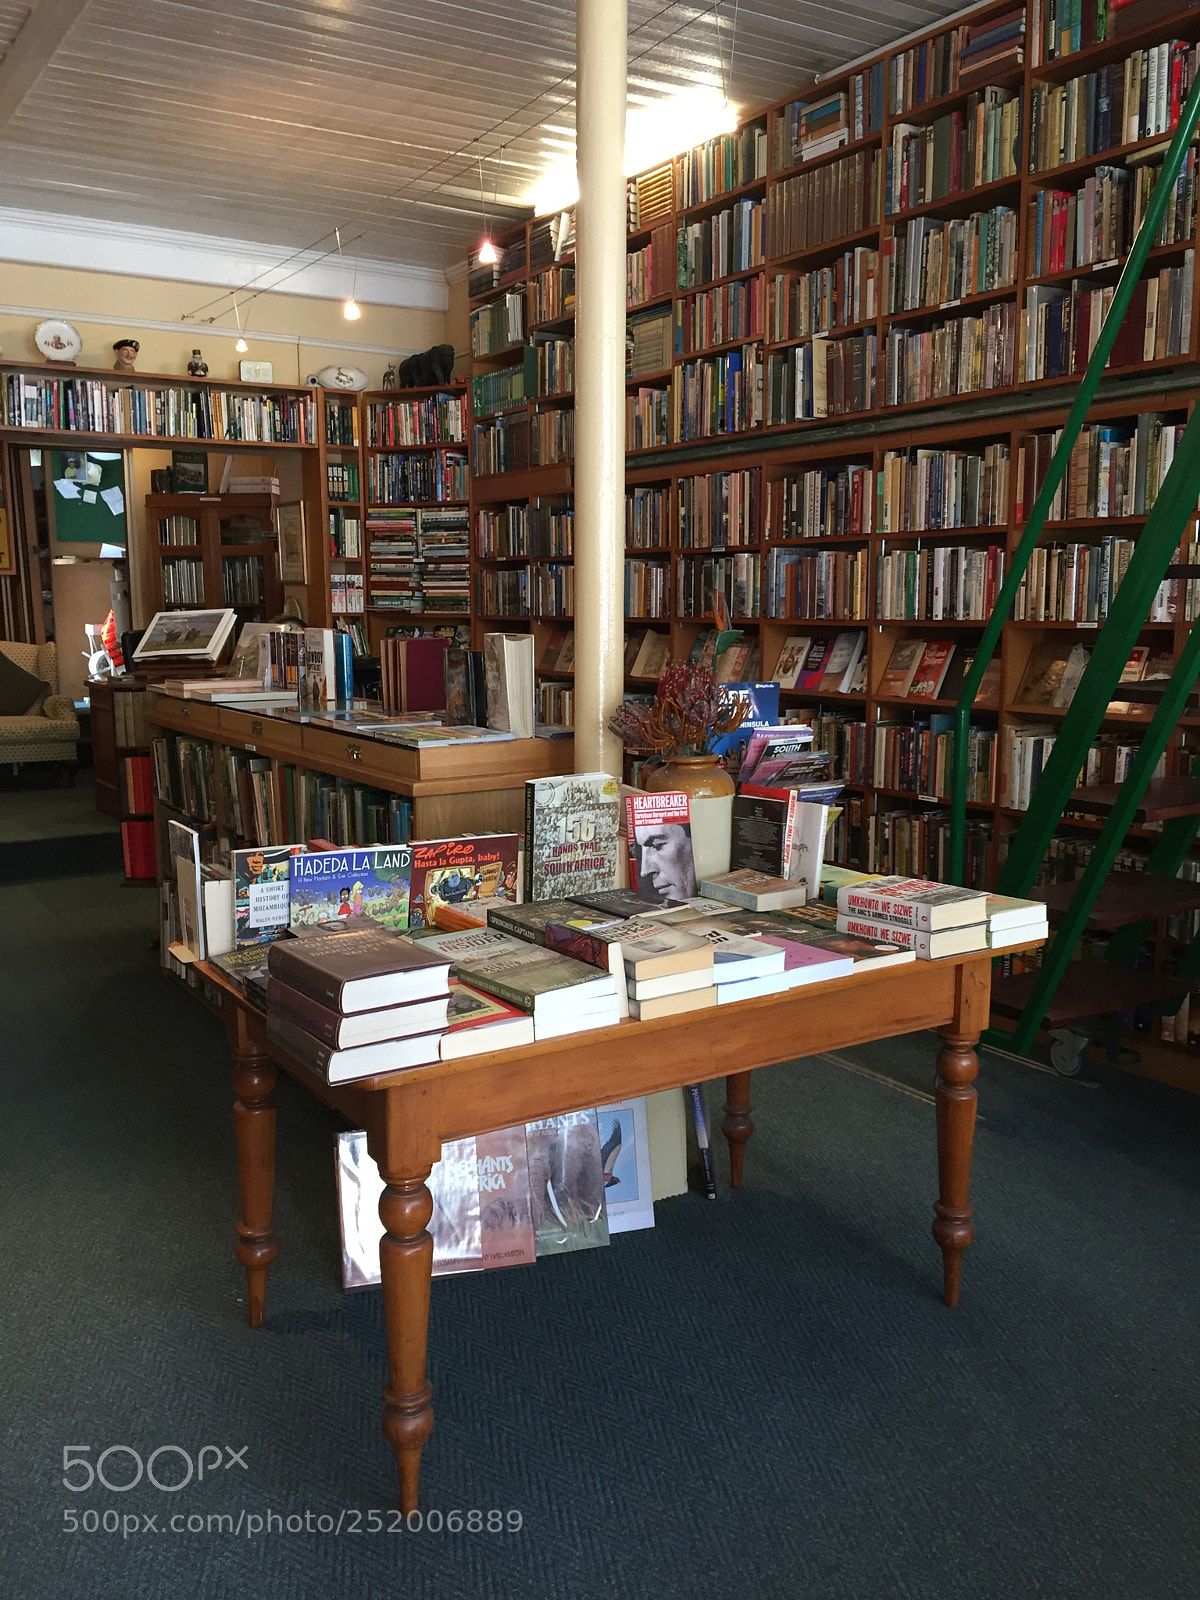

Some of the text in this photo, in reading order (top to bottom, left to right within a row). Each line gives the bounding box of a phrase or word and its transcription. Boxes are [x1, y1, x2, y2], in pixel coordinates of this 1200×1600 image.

[773, 744, 801, 753] SOUTH
[633, 794, 688, 809] HEARTBREAKER
[557, 813, 596, 844] 156
[552, 841, 599, 857] HANDS THAT
[294, 852, 410, 877] HADEDA LA LAND
[414, 860, 437, 868] Hasta
[449, 856, 475, 865] Gupta,
[478, 852, 500, 863] baby!
[544, 857, 605, 876] SOUTH AFRICA
[347, 871, 369, 879] Collection
[255, 894, 280, 903] HISTORY
[848, 894, 879, 911] UMKHONTO
[881, 901, 891, 913] WE
[893, 903, 913, 918] SIZWE
[848, 906, 856, 914] THE
[857, 908, 871, 917] ANC'S
[872, 911, 888, 921] ARMED
[889, 914, 913, 926] STRUGGLE
[437, 932, 489, 945] MAVERICK
[514, 924, 535, 940] CAPTAINS
[847, 921, 878, 937] UMKHONTO
[880, 928, 890, 940] WE
[892, 930, 912, 945] SIZWE
[438, 933, 508, 952] INSIDER
